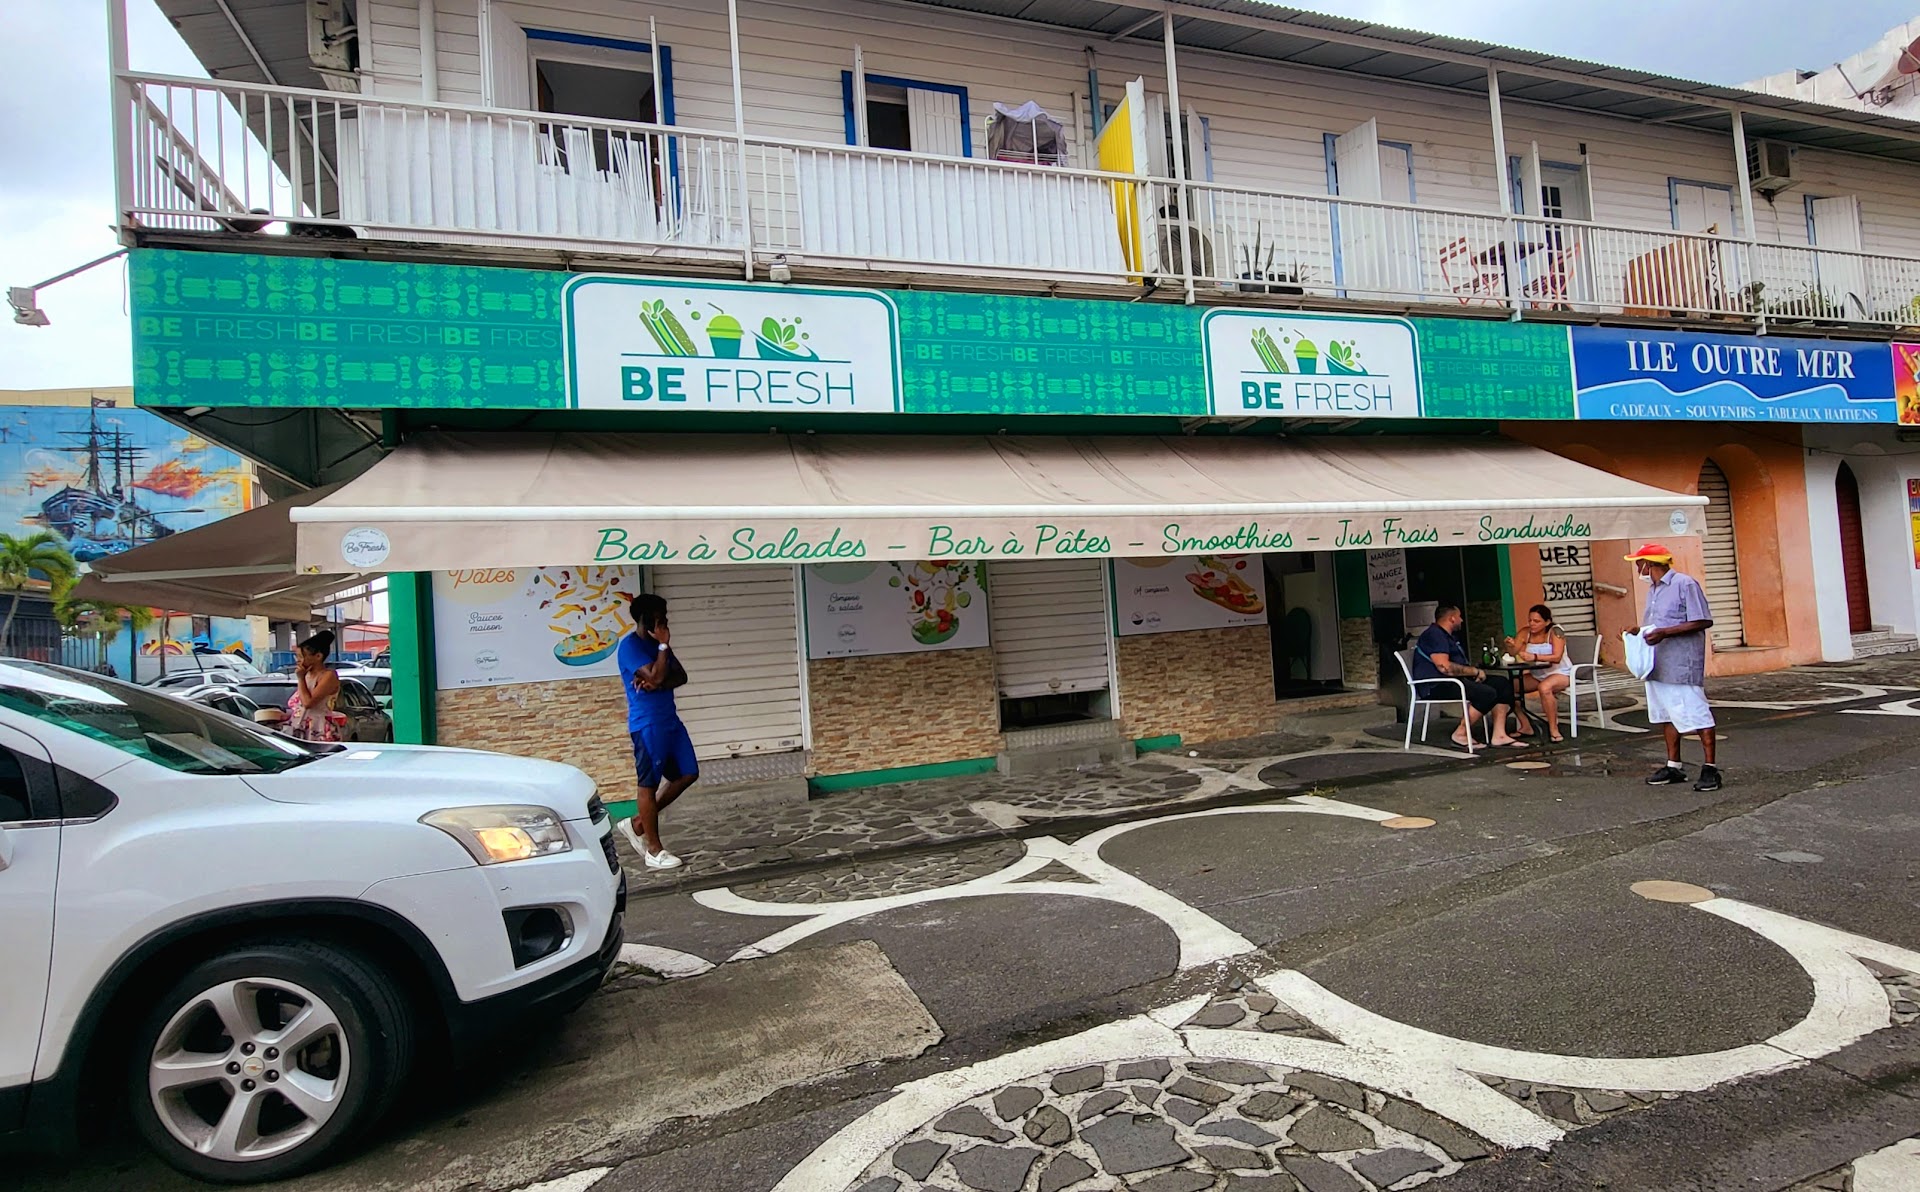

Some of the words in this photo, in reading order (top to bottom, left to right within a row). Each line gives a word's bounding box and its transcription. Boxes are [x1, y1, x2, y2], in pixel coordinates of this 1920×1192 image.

[1625, 340, 1678, 373] ILE
[1691, 343, 1783, 376] OUTRE
[1796, 349, 1855, 379] MER
[621, 366, 687, 402] BE
[705, 368, 855, 405] FRESH
[1241, 381, 1284, 410] BE
[1295, 383, 1393, 411] FRESH
[1609, 403, 1671, 418] CADEAUX
[1686, 404, 1756, 419] SOUVENIRS
[1766, 406, 1821, 420] TABLEAUX
[1824, 407, 1878, 421] HAITIENS
[594, 528, 679, 561] Bar
[687, 534, 717, 561] à
[728, 527, 867, 561] Salades
[928, 525, 994, 556] Bar
[1001, 531, 1025, 554] à
[1035, 524, 1111, 556] Pâtes
[1161, 522, 1293, 553] Smoothies
[1335, 519, 1373, 548] Jus
[1383, 518, 1439, 545] Frais
[1478, 513, 1592, 542] Sandwiches
